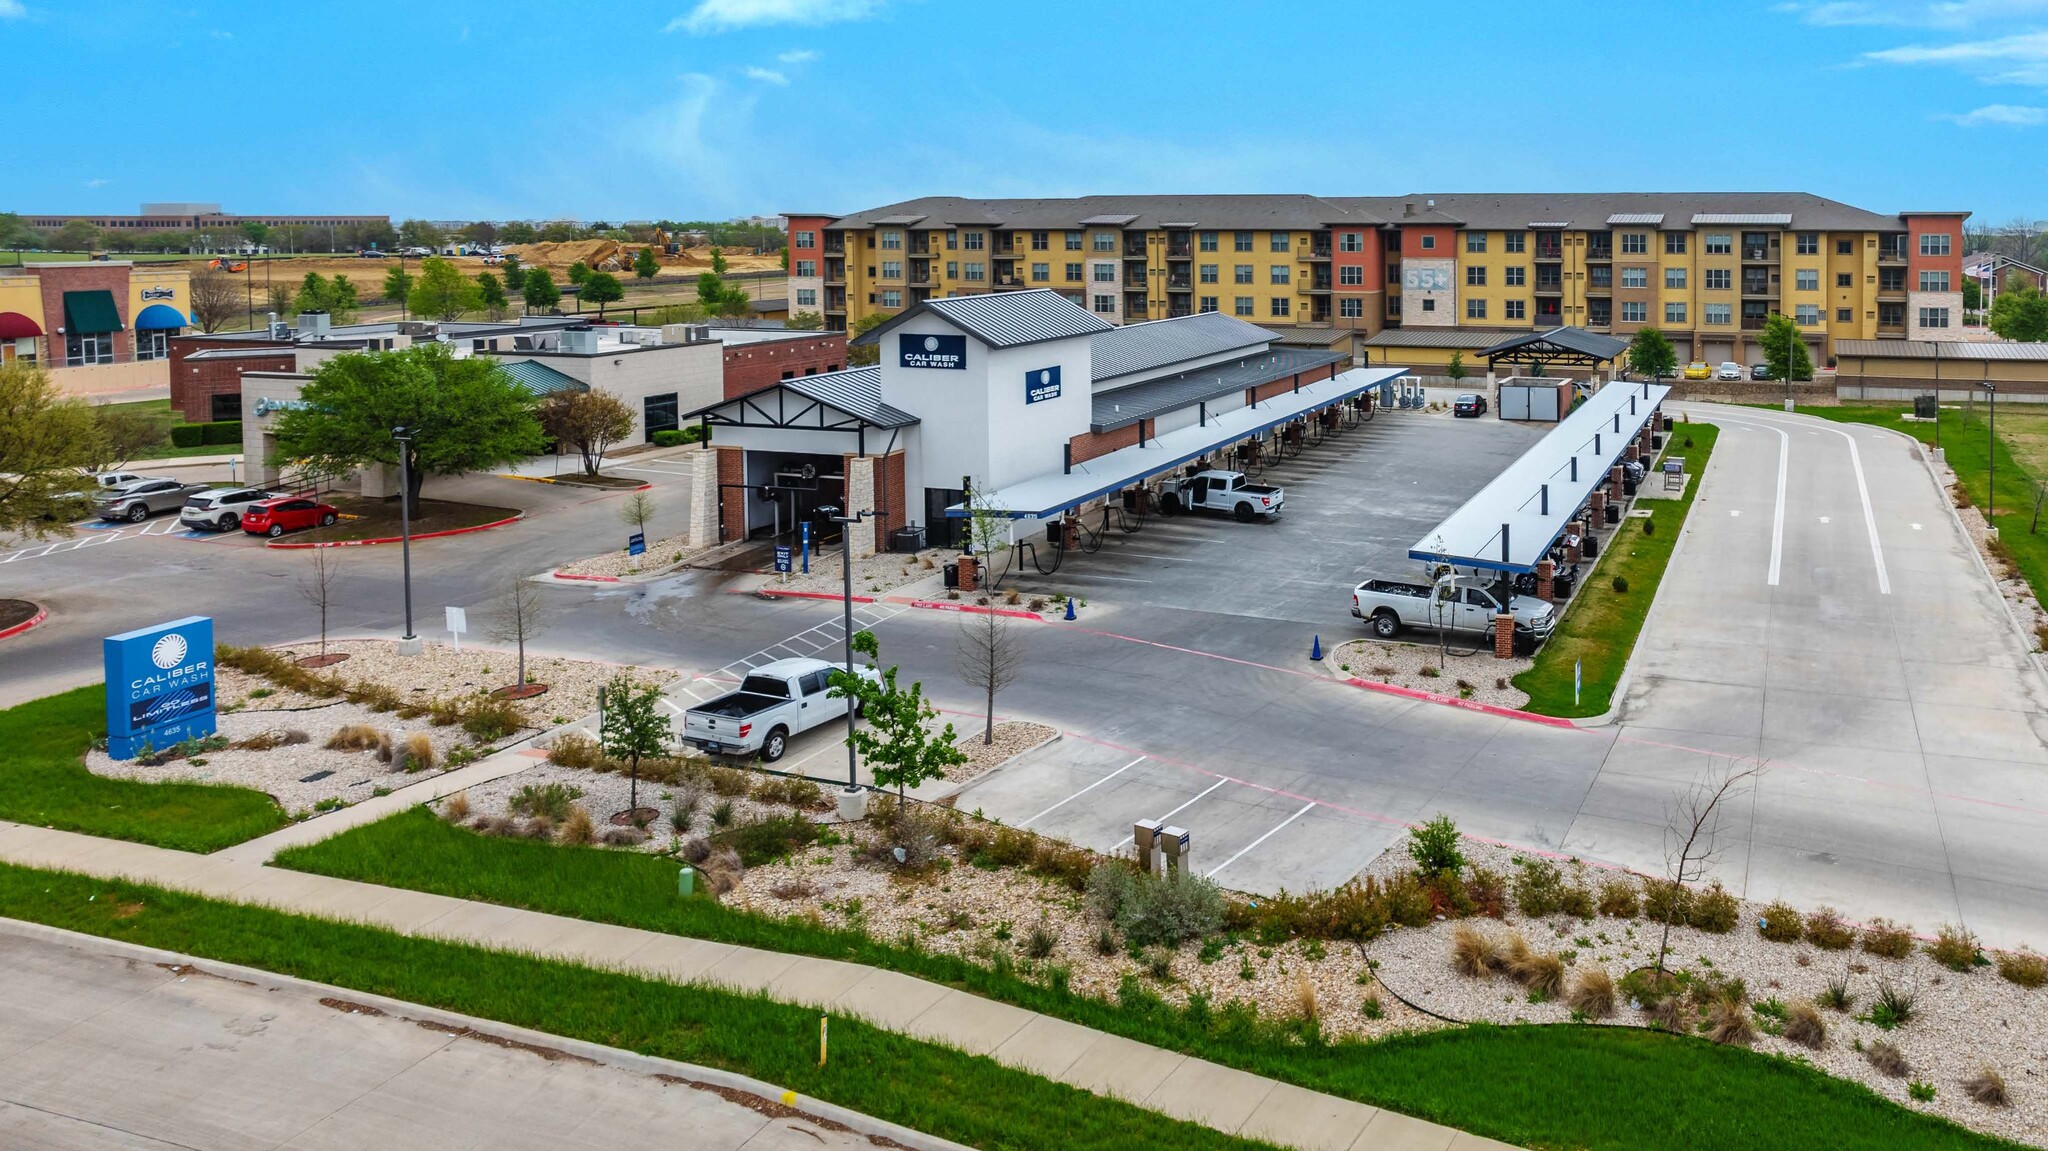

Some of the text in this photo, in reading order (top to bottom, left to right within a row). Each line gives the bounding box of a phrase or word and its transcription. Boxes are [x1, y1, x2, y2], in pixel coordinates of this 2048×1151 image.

[904, 353, 959, 362] CALIBER
[1030, 384, 1060, 397] CALIBER
[1044, 391, 1058, 399] WASH
[131, 661, 207, 689] CALIBER
[131, 671, 208, 700] CAR WASH
[132, 695, 208, 722] LIMITLESS
[163, 725, 181, 736] 4635
